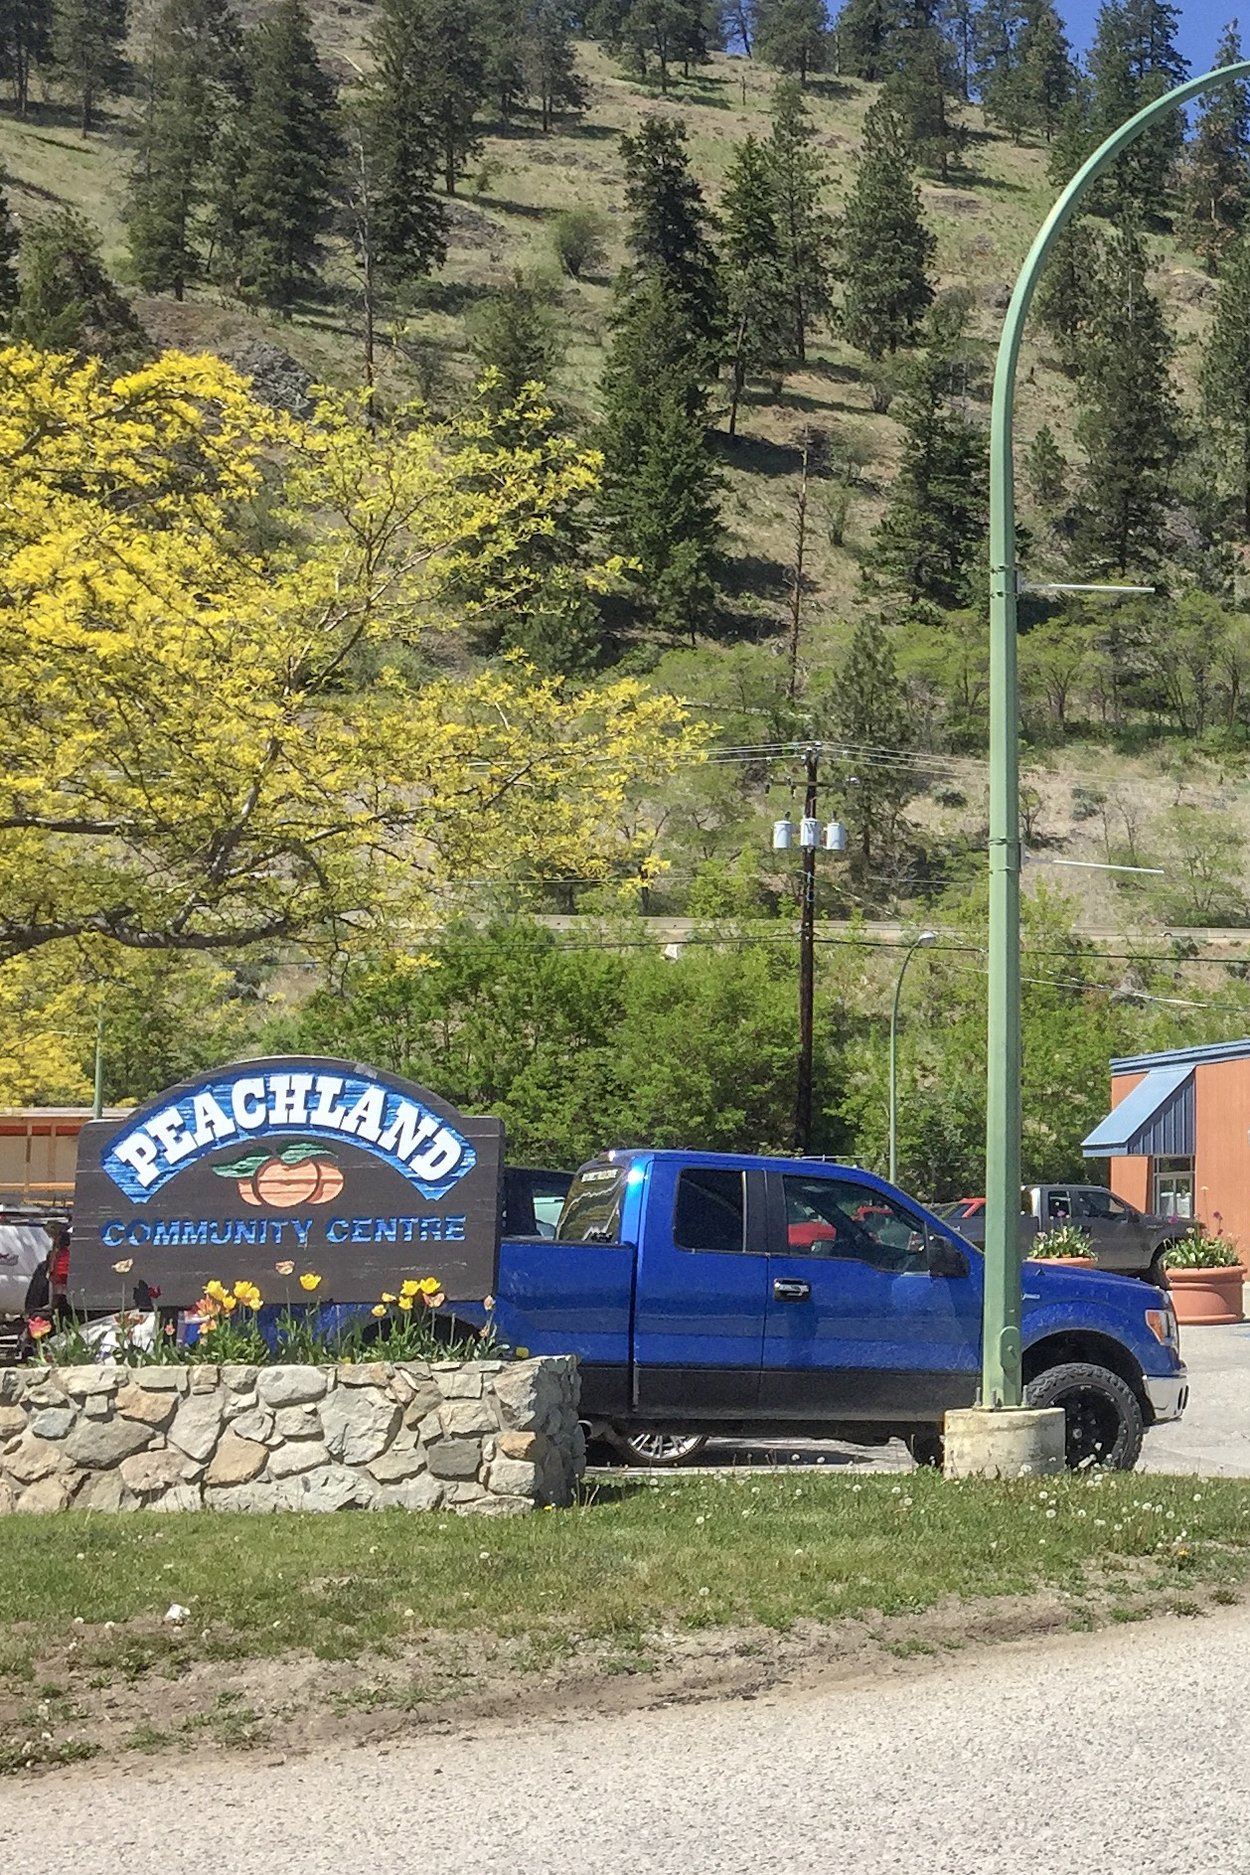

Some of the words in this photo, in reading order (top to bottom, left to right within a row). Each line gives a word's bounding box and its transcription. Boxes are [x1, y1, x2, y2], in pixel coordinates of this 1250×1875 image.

[113, 1073, 463, 1188] PEACHLAND
[102, 1217, 313, 1248] COMMUNITY
[325, 1216, 466, 1242] CENTRE
